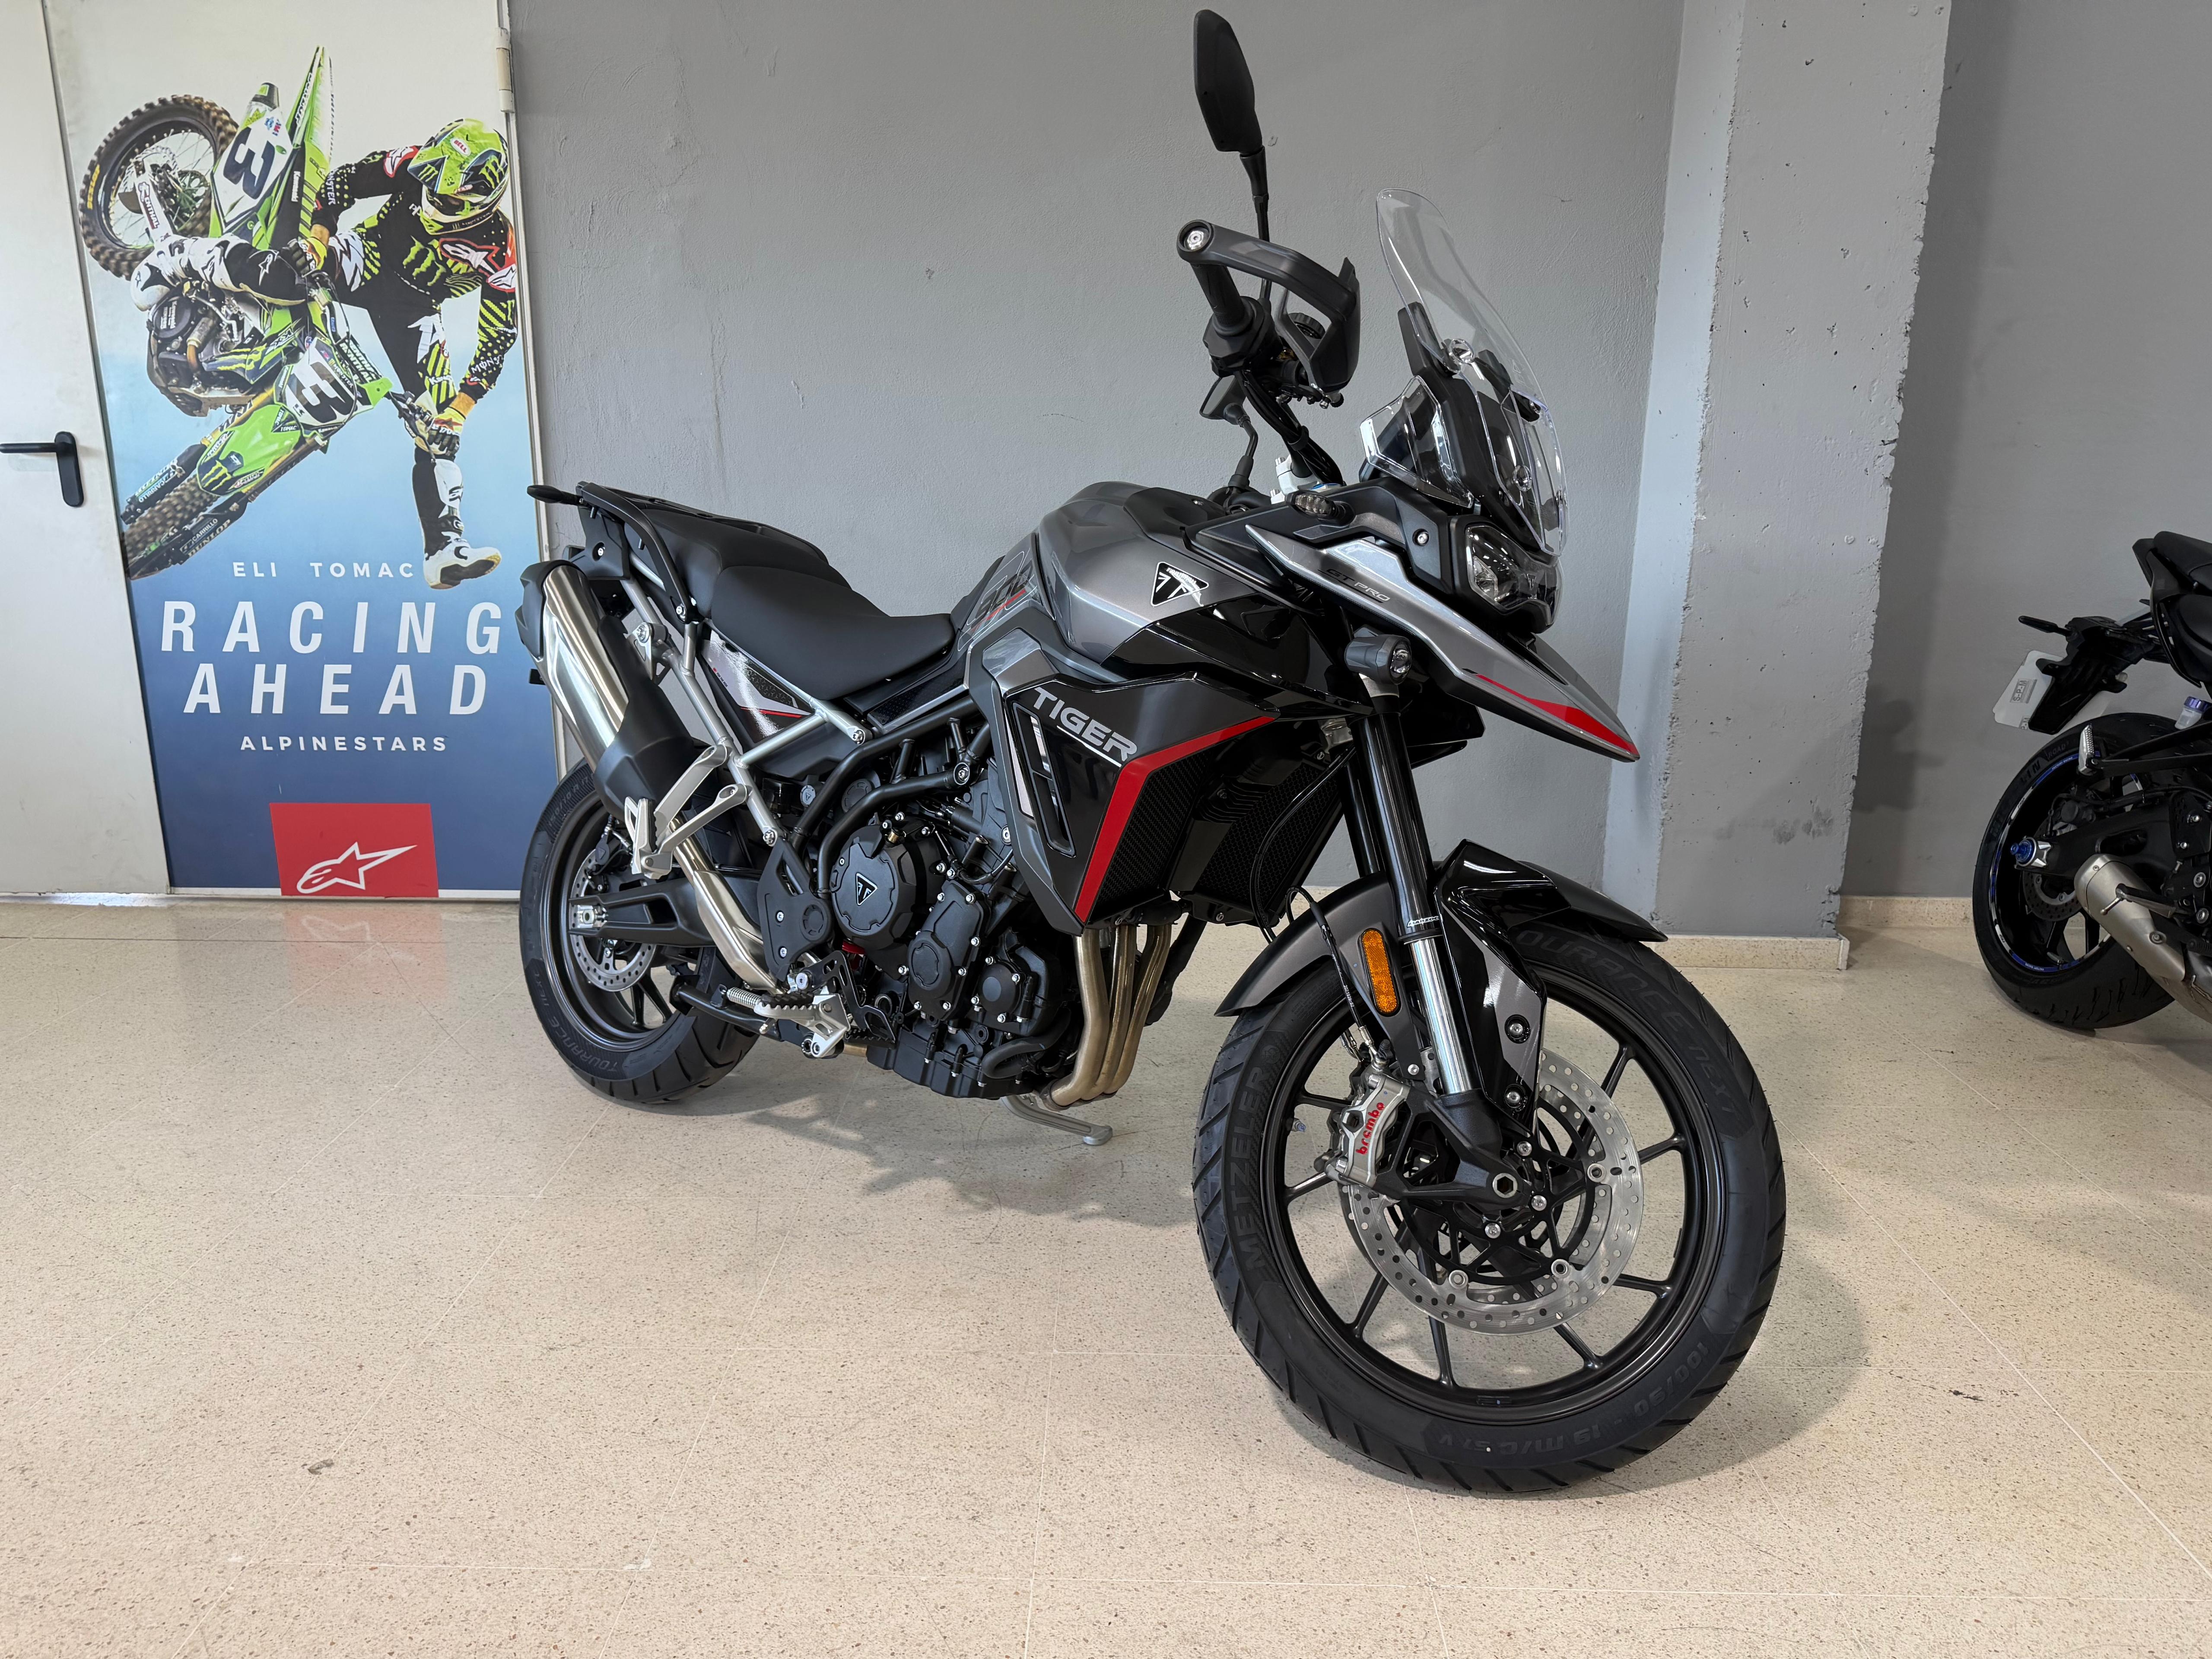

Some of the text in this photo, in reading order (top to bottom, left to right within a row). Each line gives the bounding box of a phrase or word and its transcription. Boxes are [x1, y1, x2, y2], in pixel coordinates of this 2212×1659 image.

[223, 126, 275, 200] 3
[453, 140, 467, 153] BELL
[287, 362, 359, 423] 3
[333, 363, 354, 388] MONSTER
[138, 480, 165, 503] CARRILLO
[188, 519, 231, 558] DUNLOP
[192, 518, 218, 542] CARRILLO
[232, 562, 415, 578] ELI TOMAC
[1326, 569, 1390, 601] GT PRO
[161, 600, 502, 655] RACING
[183, 663, 487, 715] AHEAD
[2013, 680, 2027, 701] S-P-M
[1034, 687, 1138, 762] TIGER
[240, 736, 447, 752] ALPINESTARS
[550, 1017, 618, 1073] TOURANCE
[1355, 1102, 1385, 1156] brembo
[1226, 1067, 1270, 1272] METZELER
[1634, 1341, 1710, 1417] 100/90
[1500, 1435, 1564, 1456] M/C
[1573, 1427, 1602, 1445] 19
